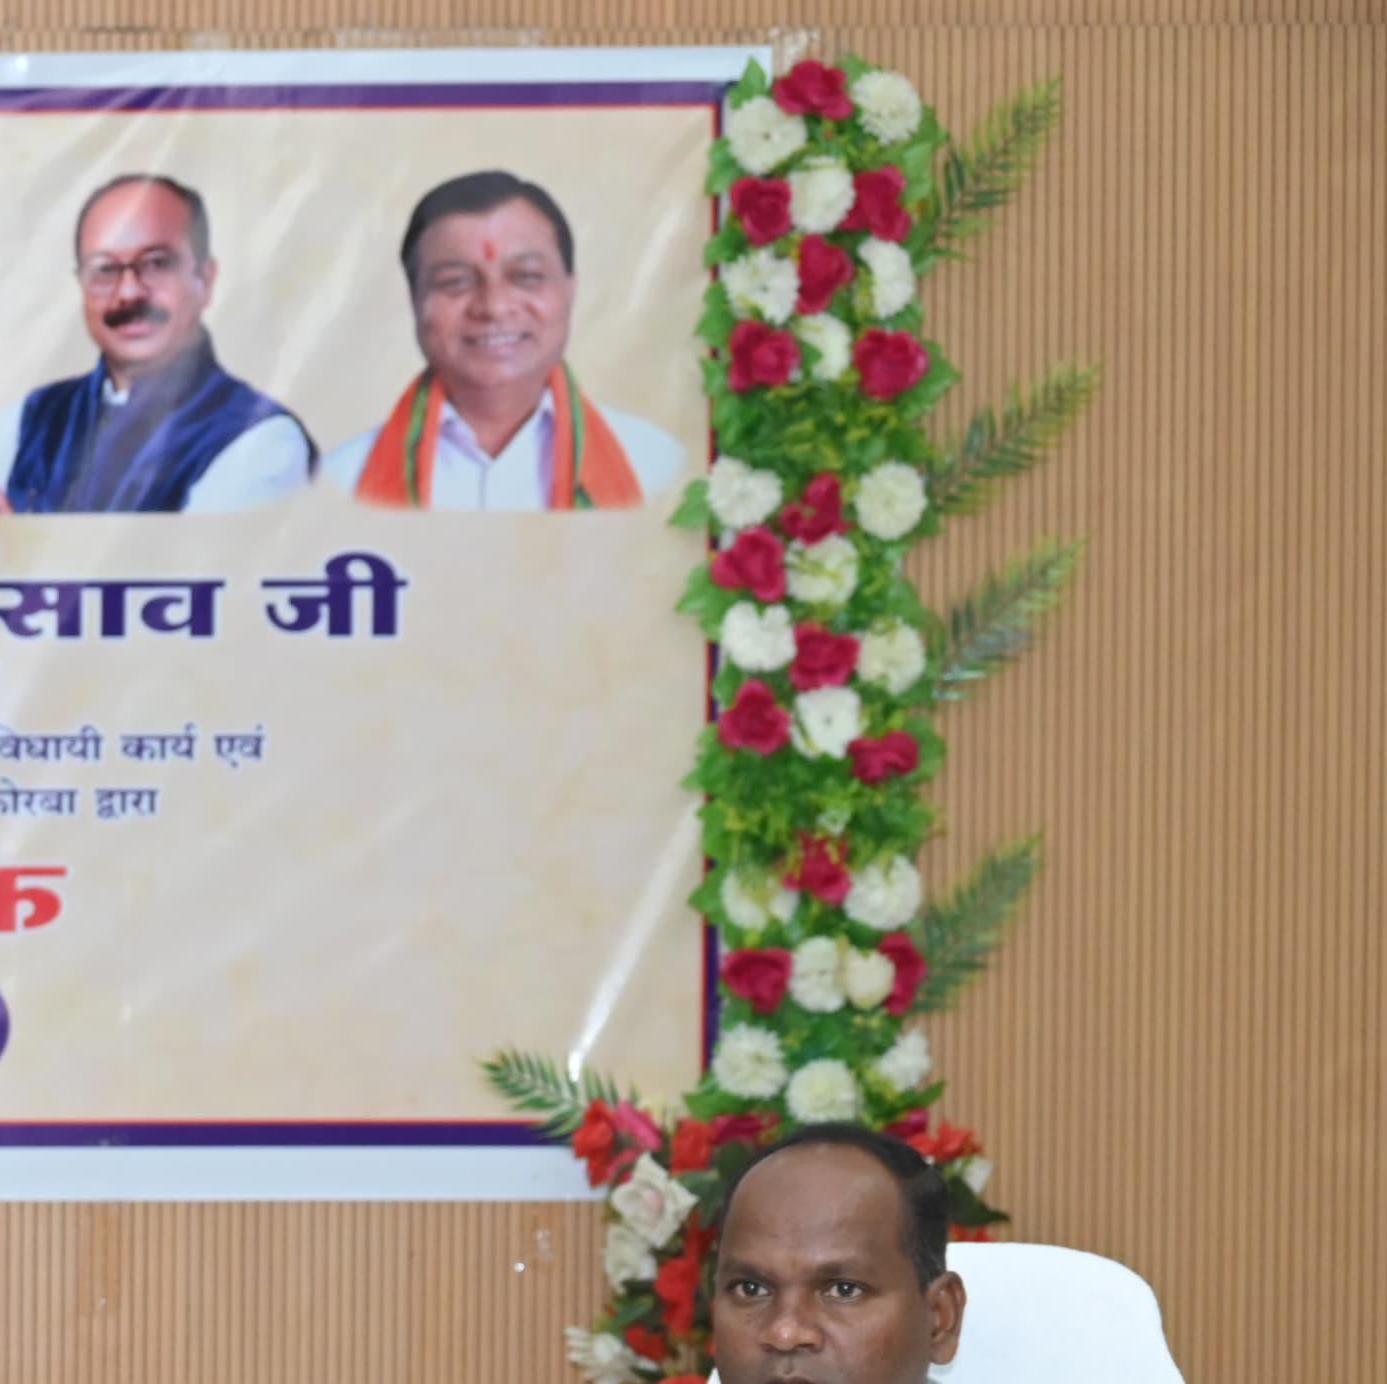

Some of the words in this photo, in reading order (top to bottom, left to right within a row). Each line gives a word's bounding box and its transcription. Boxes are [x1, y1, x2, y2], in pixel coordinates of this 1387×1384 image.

[261, 552, 408, 637] जी
[122, 723, 197, 761] कार्य
[214, 724, 265, 768] एवं
[96, 788, 159, 819] द्वारा
